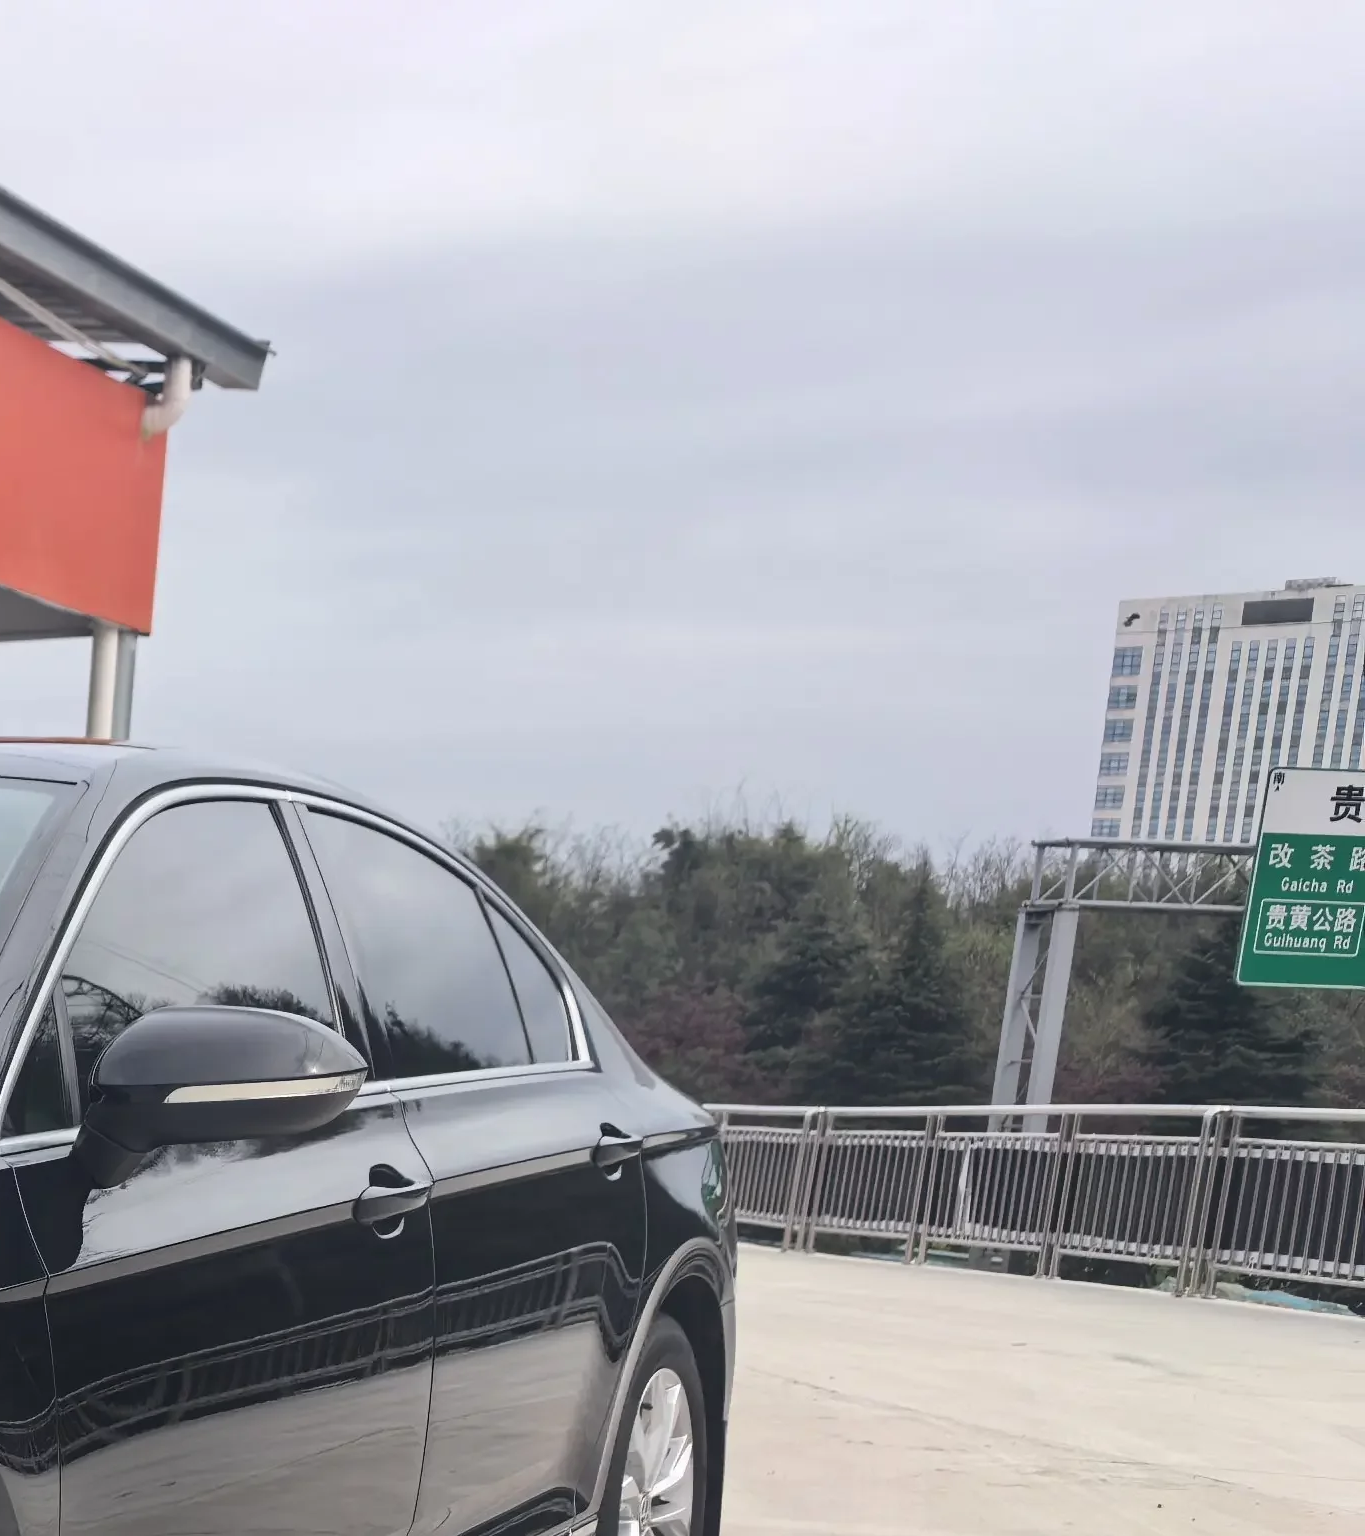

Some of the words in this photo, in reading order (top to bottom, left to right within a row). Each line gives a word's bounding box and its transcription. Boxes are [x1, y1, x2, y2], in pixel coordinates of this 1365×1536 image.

[1281, 877, 1328, 894] Gaicha
[1336, 879, 1354, 894] Rd
[1265, 904, 1357, 933] 贵黄公路
[1264, 932, 1327, 952] Guihuang
[1333, 935, 1352, 950] Rd
